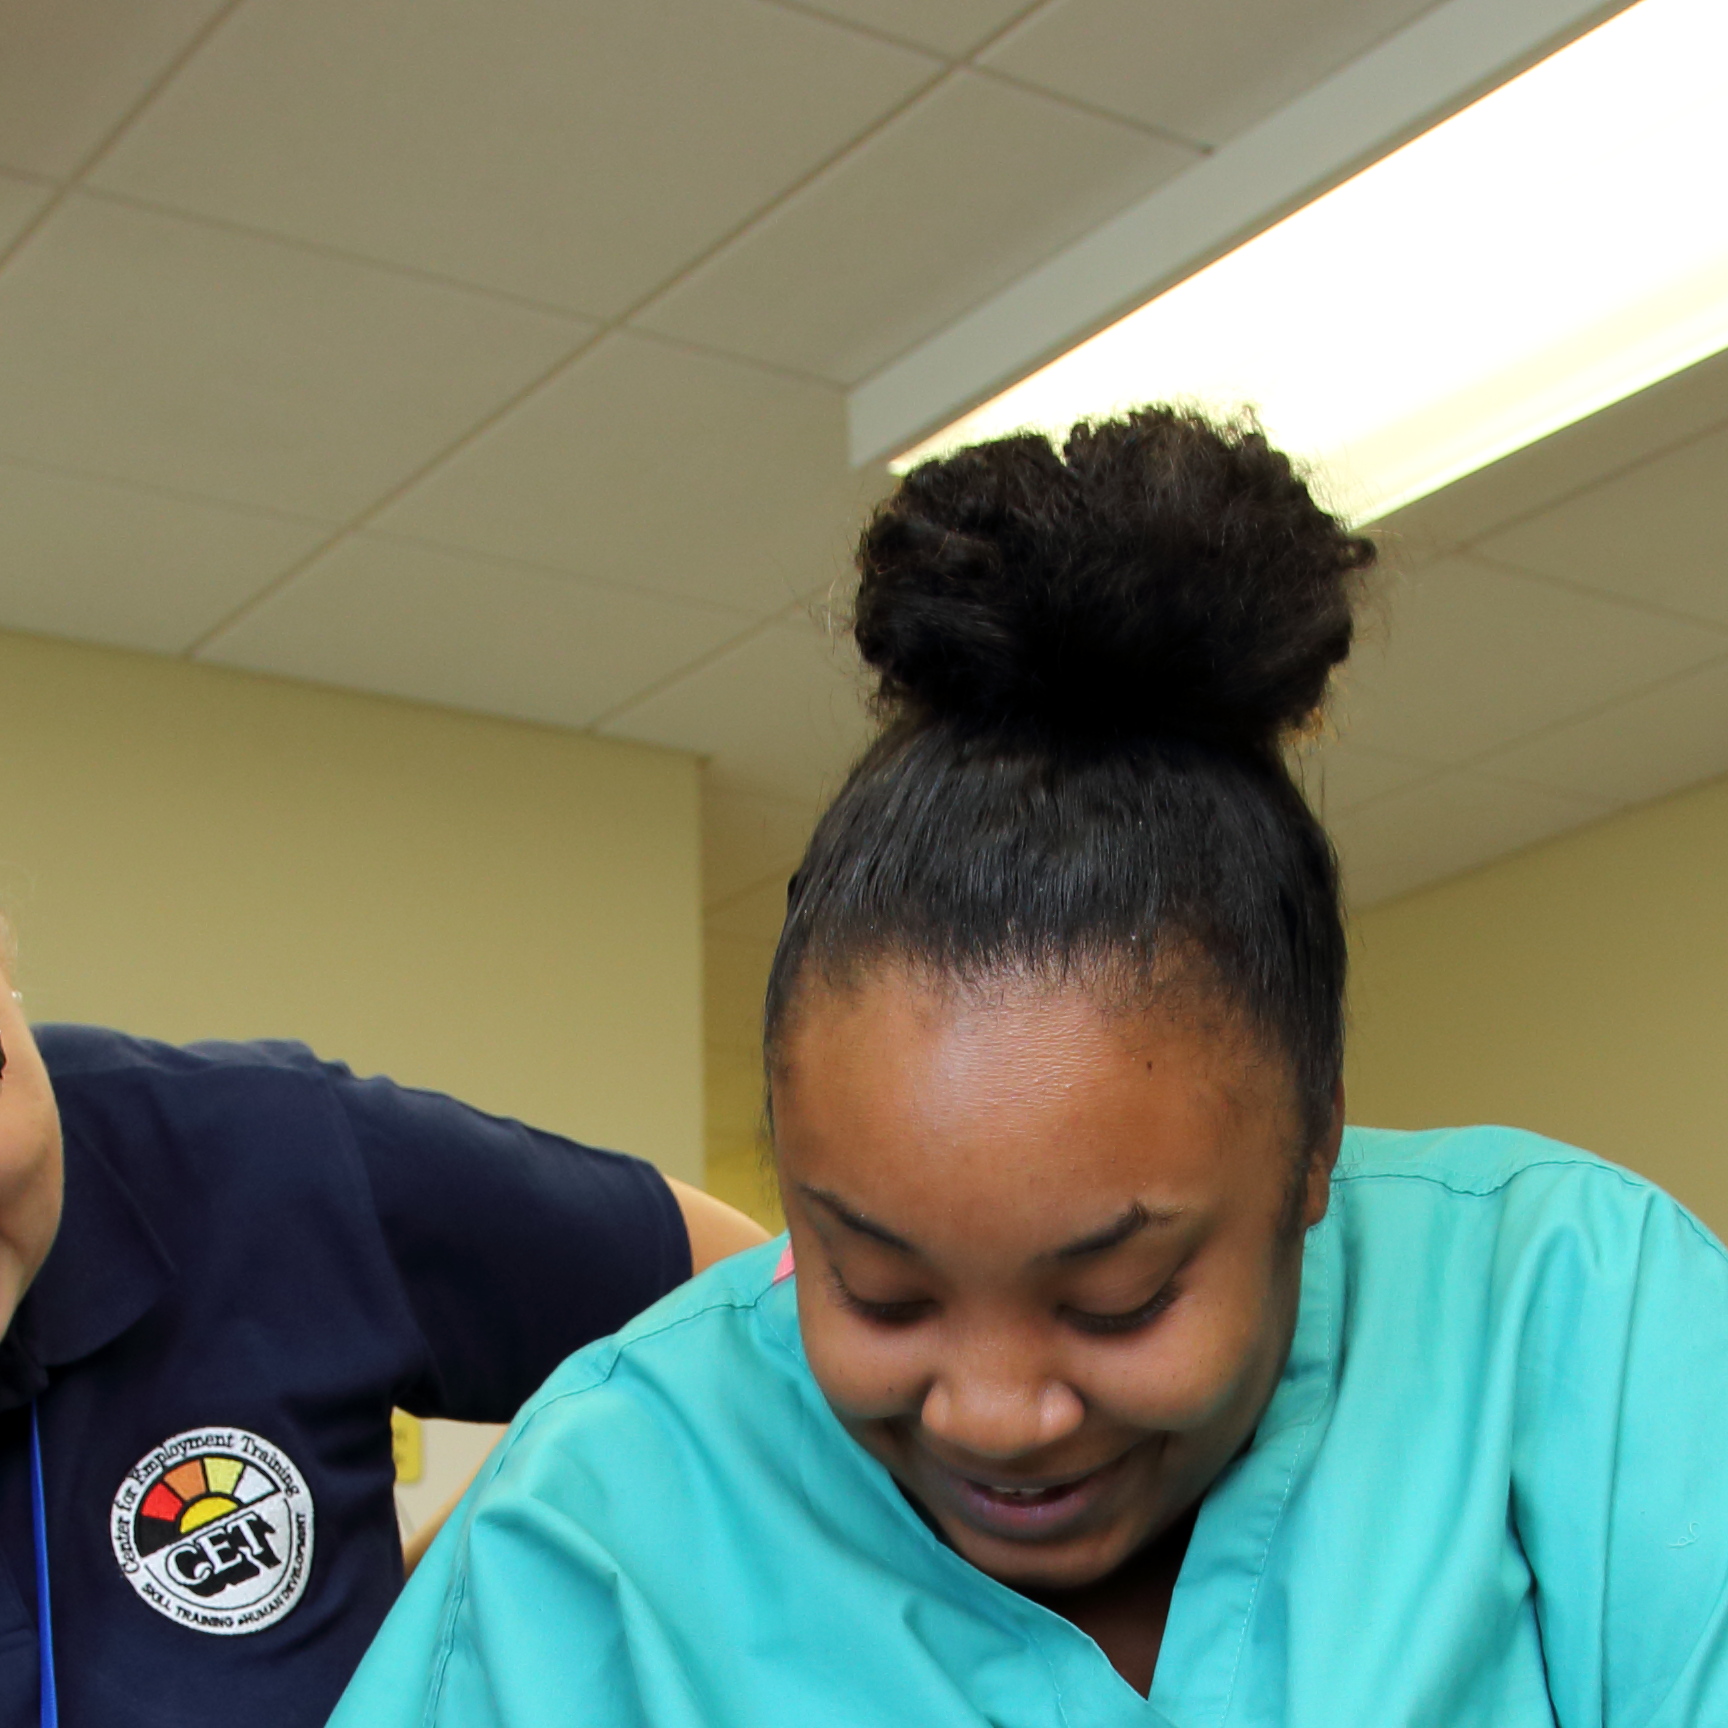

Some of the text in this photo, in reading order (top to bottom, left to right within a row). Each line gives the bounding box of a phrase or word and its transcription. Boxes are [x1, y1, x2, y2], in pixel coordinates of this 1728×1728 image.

[114, 1433, 300, 1575] Center for Employment Training
[165, 1510, 268, 1588] CET
[141, 1513, 306, 1628] SKILL TRAINING HUMAN DEVELOPMENT
